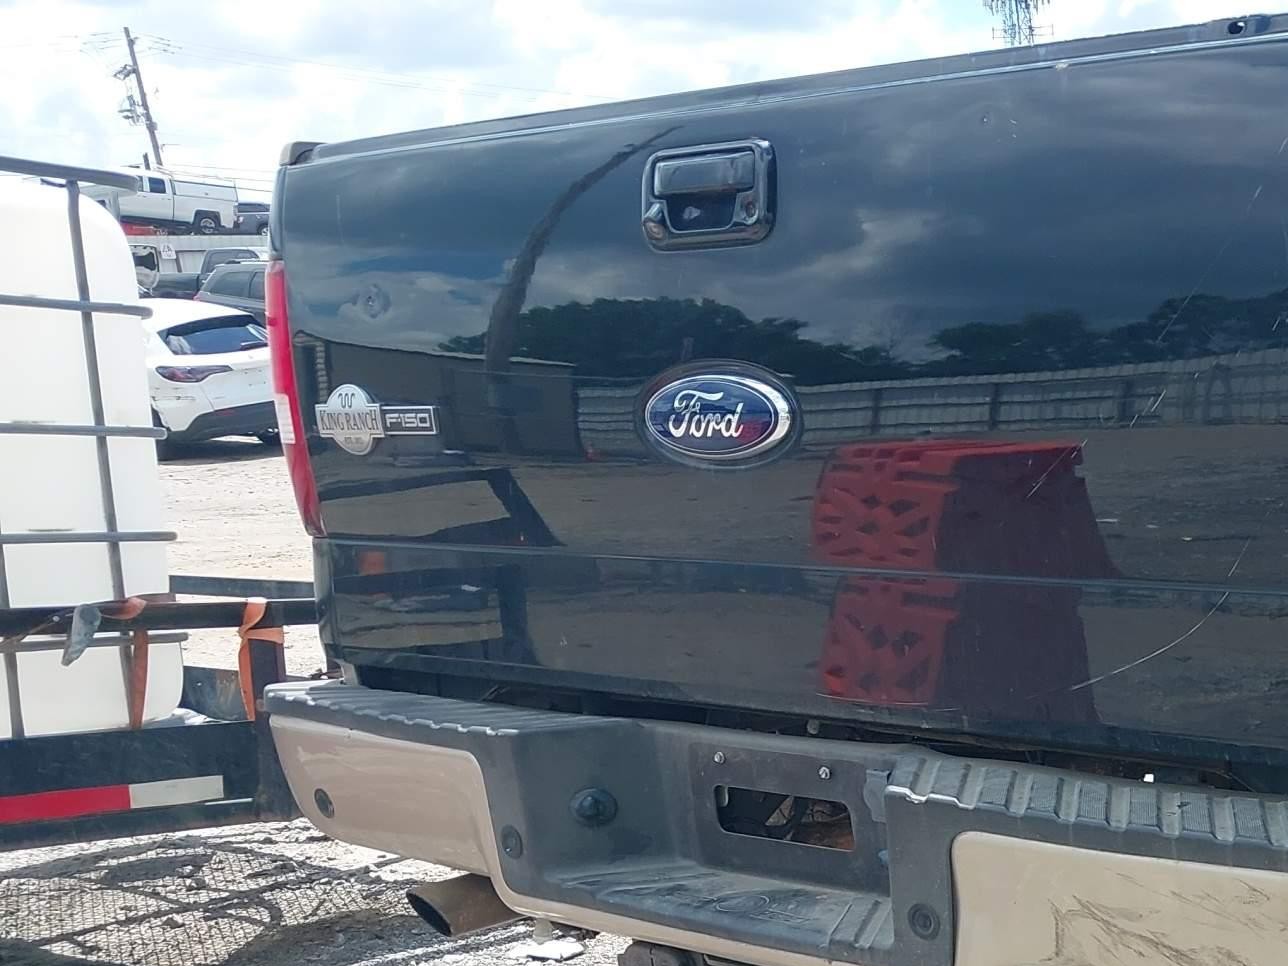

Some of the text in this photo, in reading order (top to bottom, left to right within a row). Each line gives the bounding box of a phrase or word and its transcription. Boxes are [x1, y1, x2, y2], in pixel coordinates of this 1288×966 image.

[319, 409, 380, 431] KING RANCH
[668, 389, 744, 438] Ford
